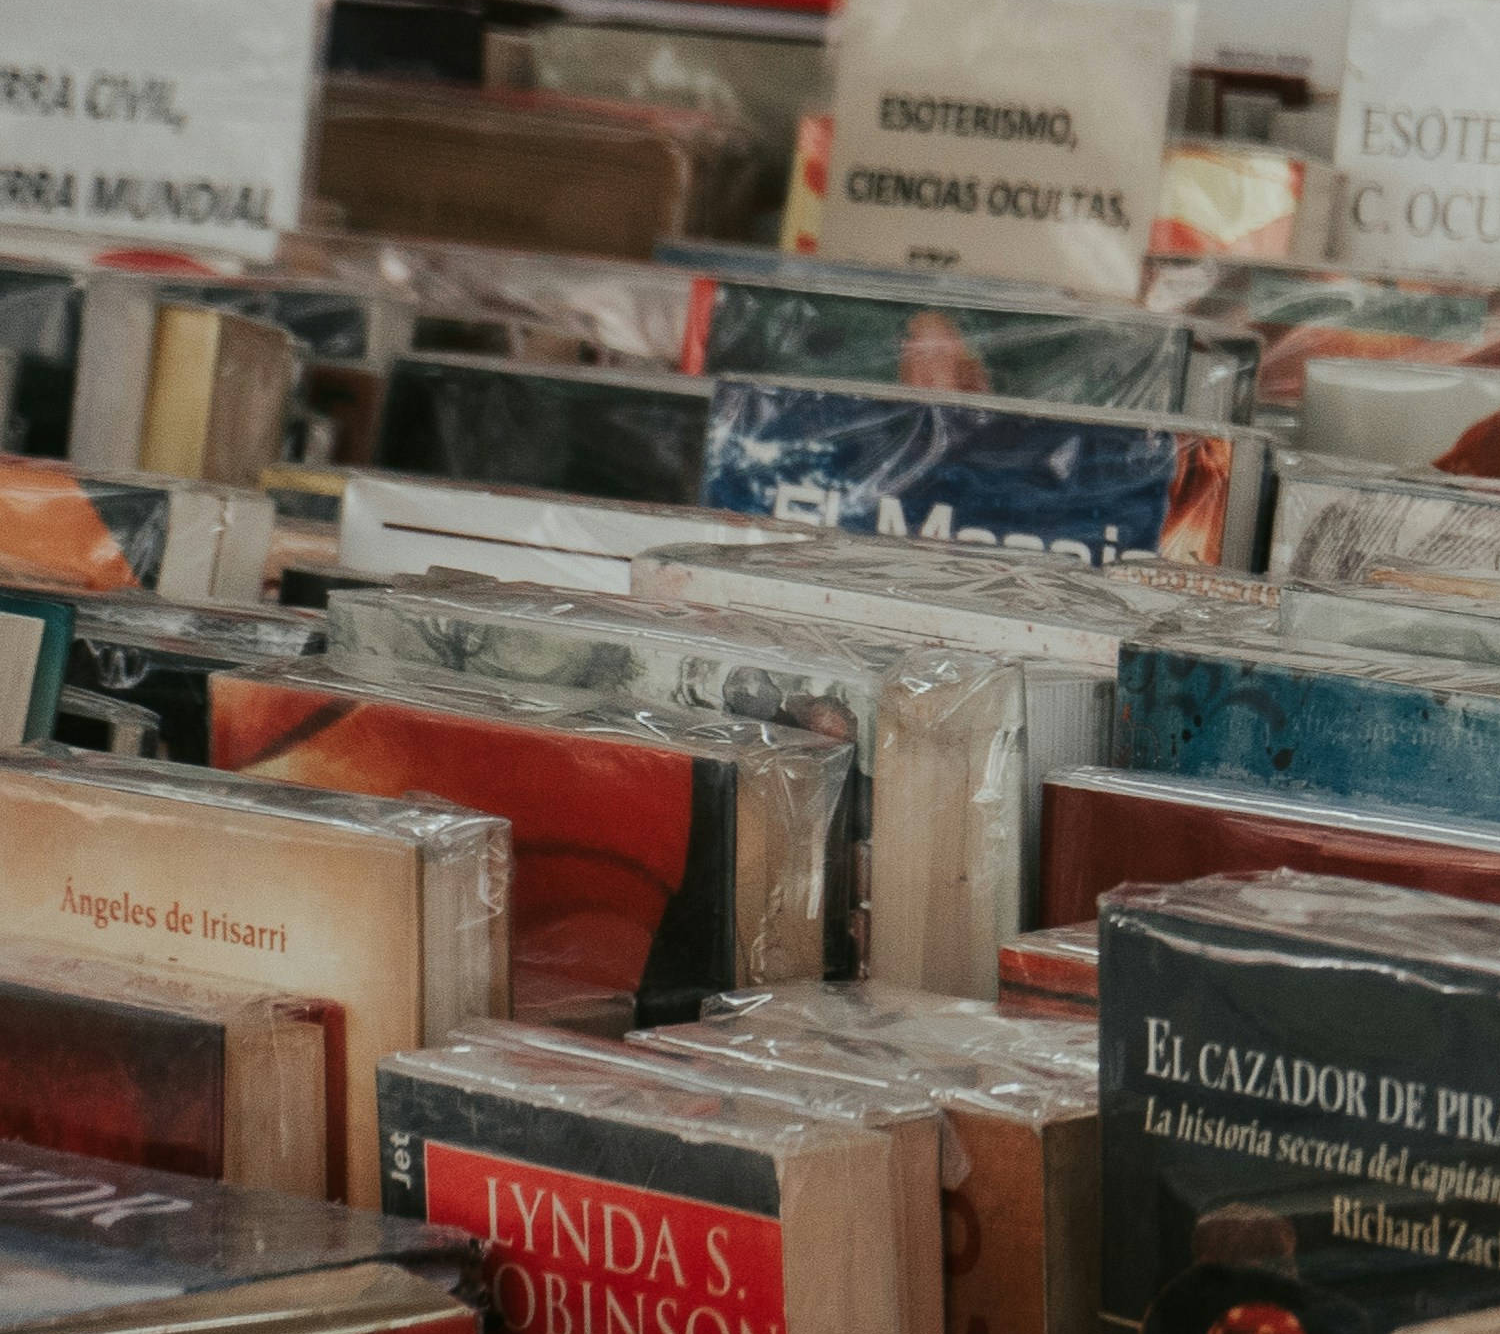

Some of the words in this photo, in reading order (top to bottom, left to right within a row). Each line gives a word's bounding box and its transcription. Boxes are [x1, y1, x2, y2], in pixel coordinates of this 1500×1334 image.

[91, 173, 275, 230] MUNDIAL
[846, 167, 979, 212] CIENCIAS
[59, 876, 157, 938] Ángeles
[165, 904, 194, 936] de
[200, 908, 287, 955] Irisarri
[1198, 1043, 1368, 1119] CAZADOR
[1376, 1069, 1428, 1124] DE
[389, 1131, 411, 1190] Jet
[1143, 1097, 1171, 1138] La
[1176, 1102, 1272, 1158] historia
[1276, 1125, 1362, 1174] secreta
[1368, 1137, 1408, 1185] del
[485, 1176, 691, 1291] LYNDA
[708, 1225, 748, 1302] S.
[1329, 1192, 1439, 1259] Richard
